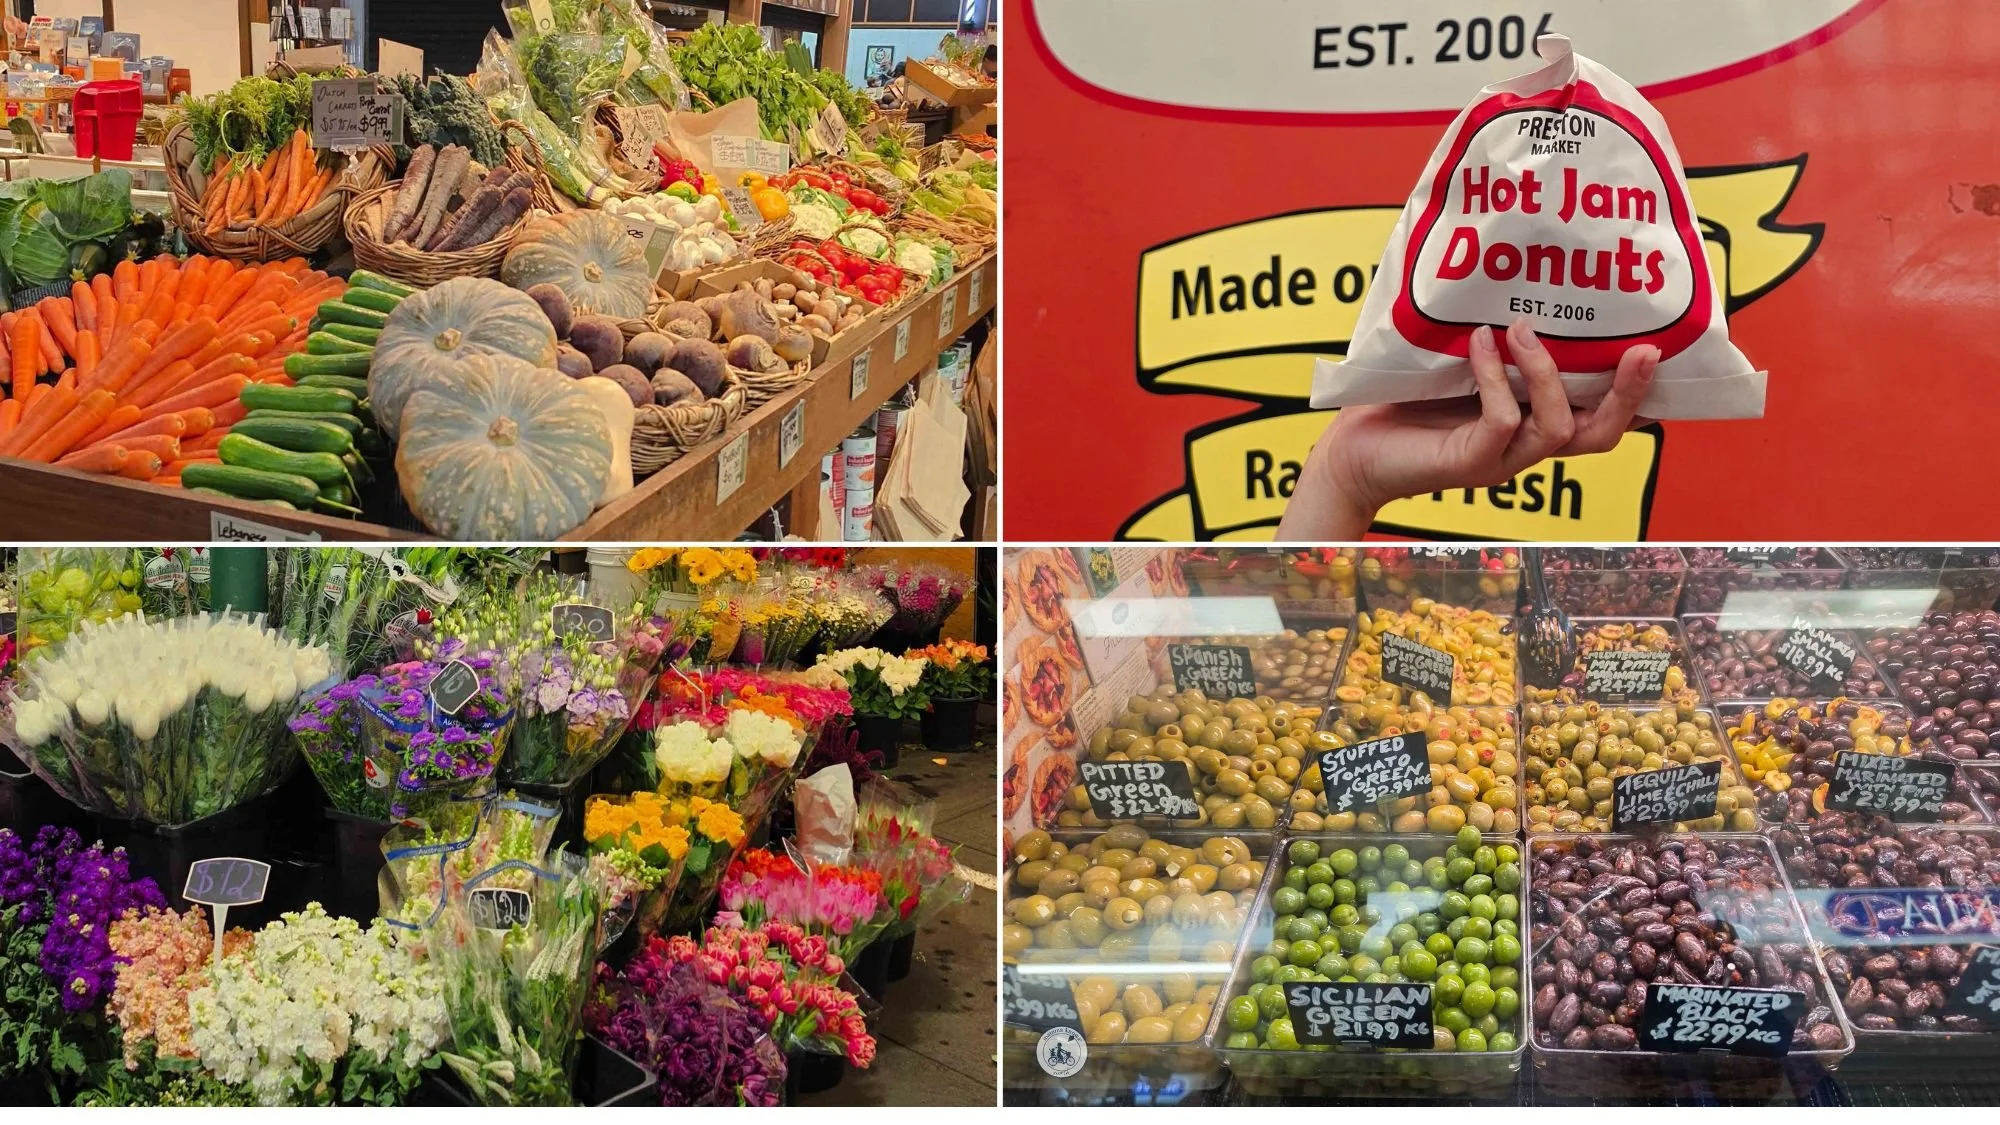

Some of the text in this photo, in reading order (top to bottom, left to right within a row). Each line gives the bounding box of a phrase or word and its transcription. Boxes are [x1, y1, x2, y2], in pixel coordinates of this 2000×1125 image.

[1313, 22, 1414, 69] EST.
[1517, 113, 1596, 140] PRESTON
[1531, 140, 1582, 155] MARKET
[1462, 166, 1657, 224] Hot Jam
[1436, 226, 1665, 295] Donuts
[1171, 254, 1317, 320] Made
[1510, 298, 1595, 321] EST. 2006
[1789, 631, 1833, 663] SMALL
[1792, 615, 1856, 662] KALAMATA
[1187, 666, 1243, 681] GREEN
[1586, 670, 1660, 682] MARINATED
[1322, 736, 1405, 773] STUFFED
[1840, 752, 1906, 771] MIXED
[1081, 762, 1166, 781] PITTED
[1351, 762, 1424, 792] GREEN
[1617, 765, 1703, 796] TEQUILA
[1835, 767, 1947, 787] MARINATED
[1089, 782, 1173, 801] Green
[1289, 985, 1431, 1006] SICILIAN
[1656, 985, 1792, 1011] MARINATED
[1306, 1004, 1416, 1025] GREEN
[1676, 1001, 1769, 1026] BLACK
